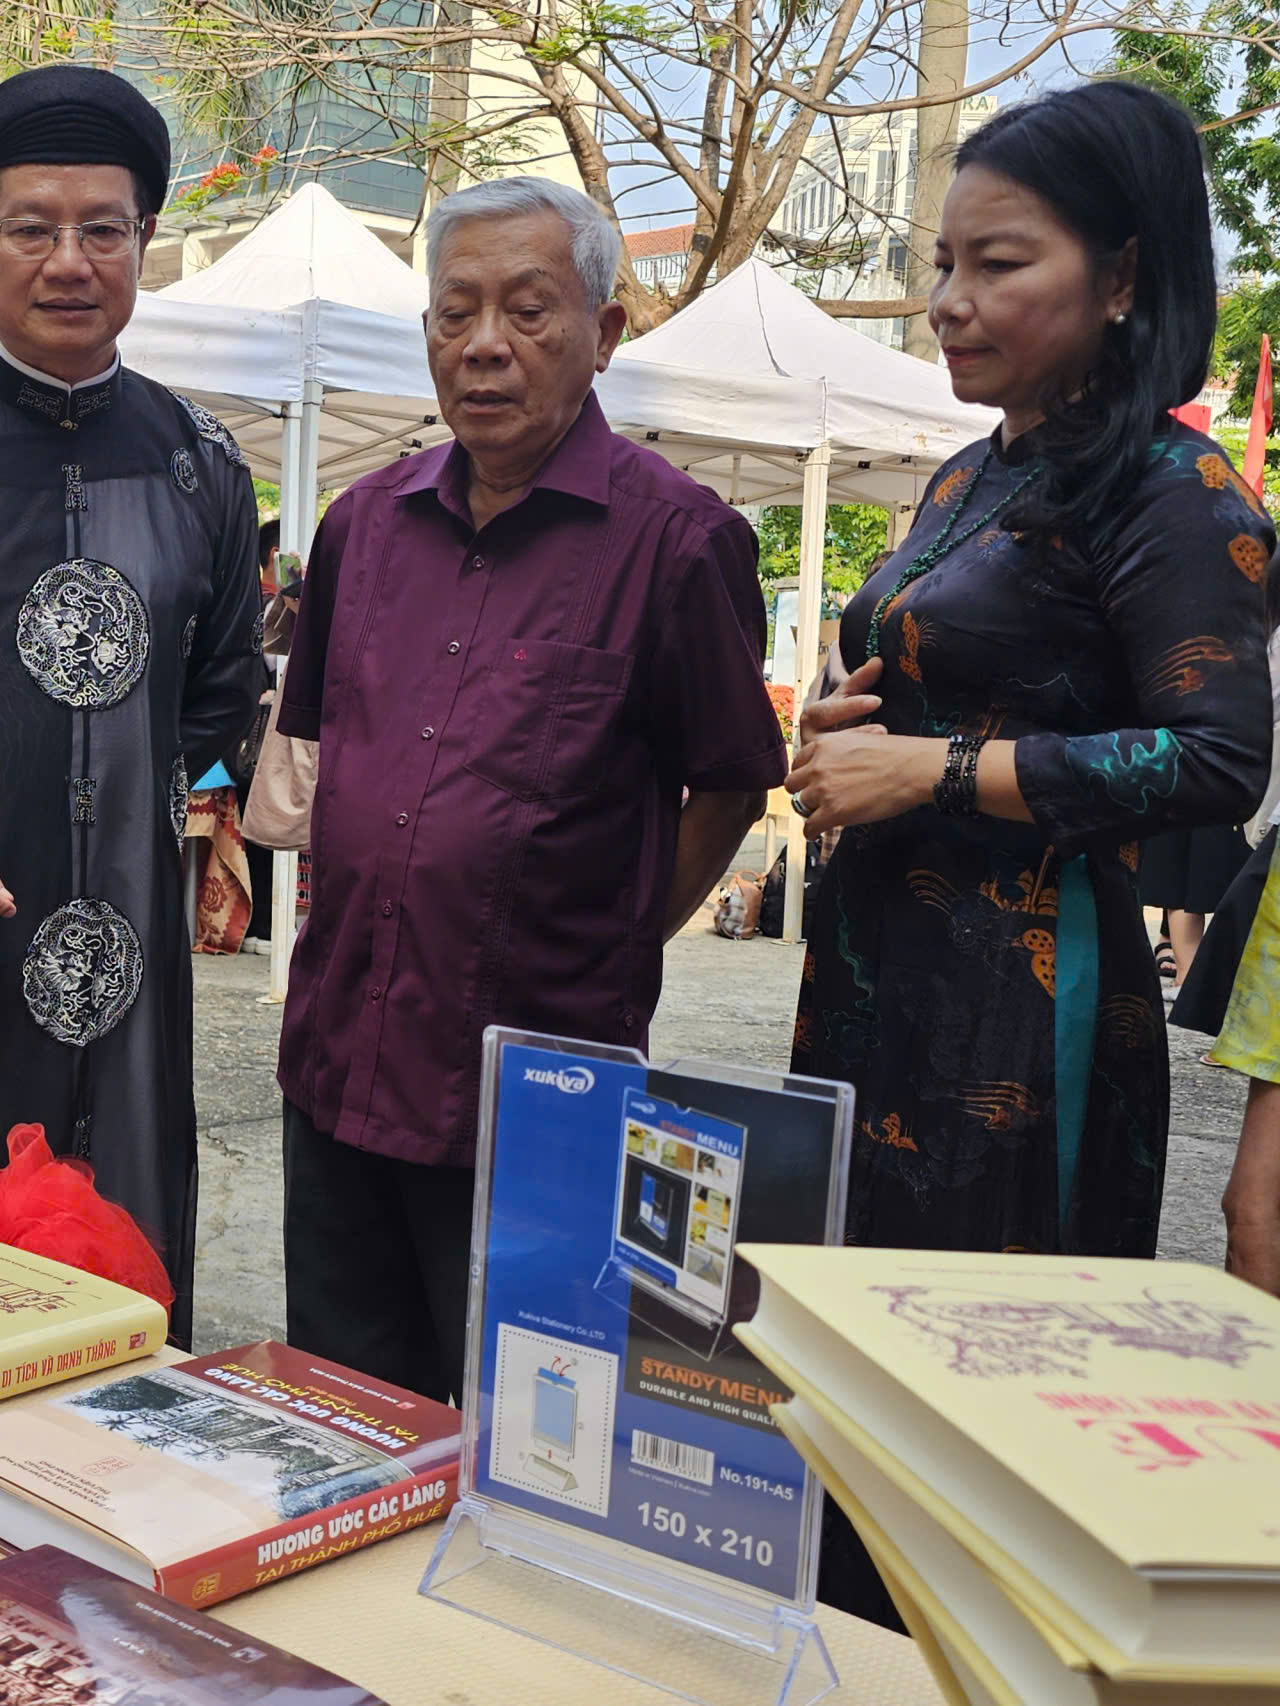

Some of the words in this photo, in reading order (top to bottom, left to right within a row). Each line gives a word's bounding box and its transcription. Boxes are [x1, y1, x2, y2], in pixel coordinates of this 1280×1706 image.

[524, 1066, 594, 1094] xukiva
[697, 1133, 738, 1155] MENU
[542, 1316, 576, 1334] Stationery
[2, 1370, 12, 1387] DI
[16, 1361, 37, 1384] TÍCH
[42, 1355, 53, 1376] VÀ
[57, 1349, 82, 1372] DANH
[86, 1338, 116, 1361] THẮNG
[218, 1362, 264, 1380] HUẾ
[641, 1357, 716, 1391] STANDY
[204, 1367, 256, 1391] LÀNG
[251, 1383, 290, 1403] CÁC
[264, 1377, 310, 1398] PHỐ
[288, 1399, 331, 1419] ƯỚC
[309, 1395, 382, 1426] THÀNH
[640, 1381, 686, 1400] DURABLE
[688, 1395, 710, 1407] AND
[713, 1401, 740, 1415] HIGH
[742, 1409, 779, 1427] QUALI
[330, 1415, 406, 1449] HƯƠNG
[385, 1424, 419, 1442] TẠI
[720, 1467, 793, 1500] No.191-A5
[258, 1524, 324, 1566] HƯƠNG
[328, 1509, 364, 1538] ƯỚC
[369, 1496, 399, 1524] CÁC
[403, 1480, 446, 1511] LÀNG
[290, 1537, 358, 1568] THÀNH
[362, 1515, 402, 1544] PHỐ
[406, 1498, 445, 1527] HUẾ
[638, 1501, 685, 1538] 150
[694, 1524, 712, 1546] x
[721, 1528, 773, 1566] 210
